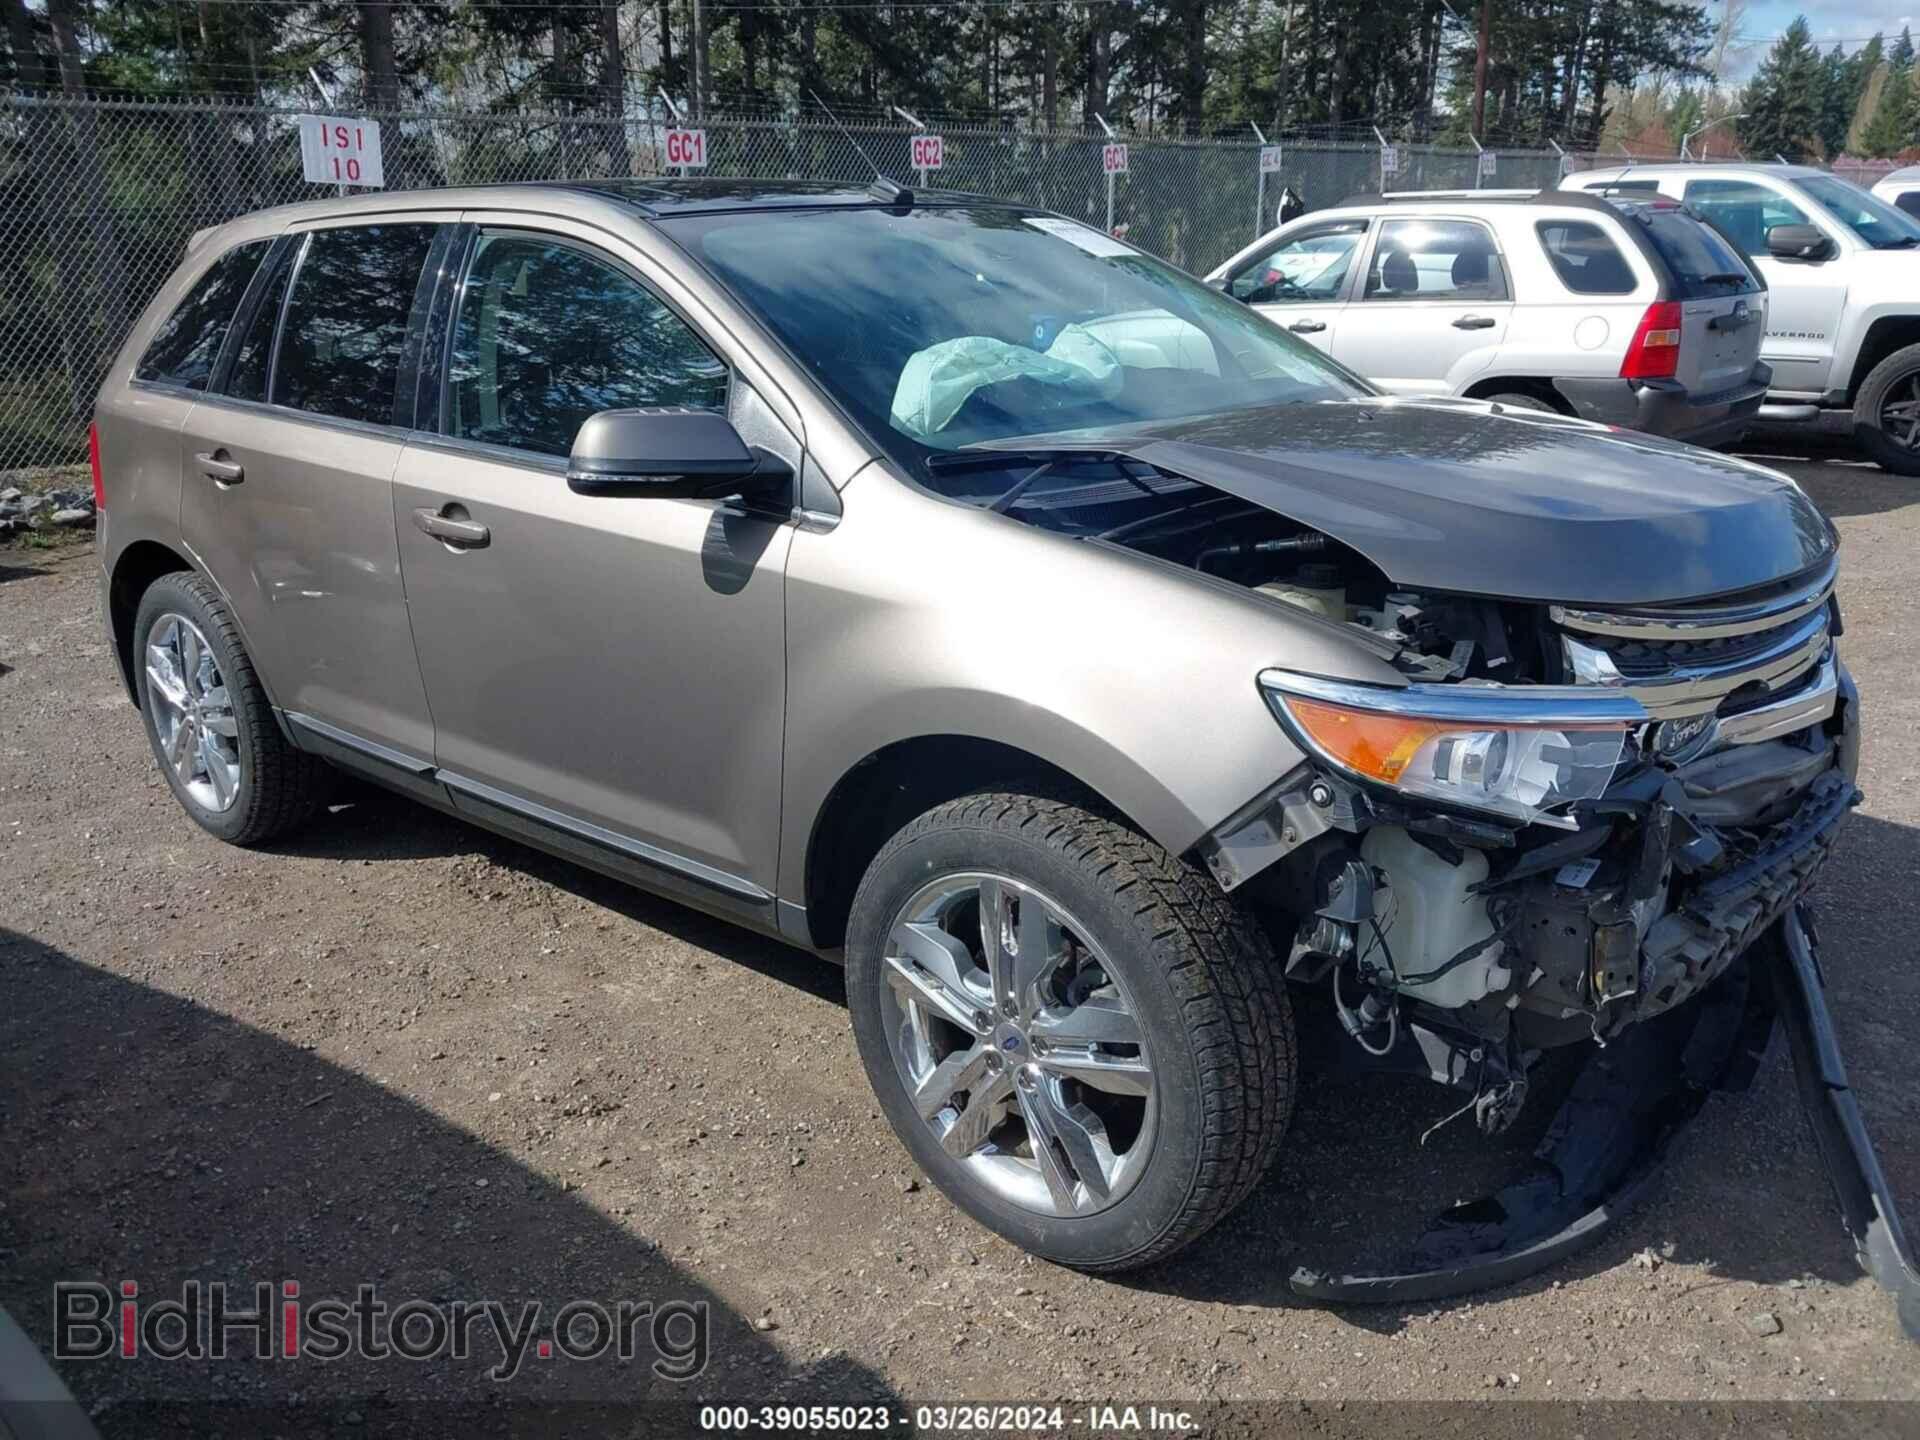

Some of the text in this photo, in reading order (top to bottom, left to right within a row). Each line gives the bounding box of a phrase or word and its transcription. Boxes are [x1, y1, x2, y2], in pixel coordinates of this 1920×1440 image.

[667, 132, 703, 162] GC1
[913, 140, 941, 165] GC2
[1105, 147, 1126, 171] GC3
[333, 157, 361, 181] 10
